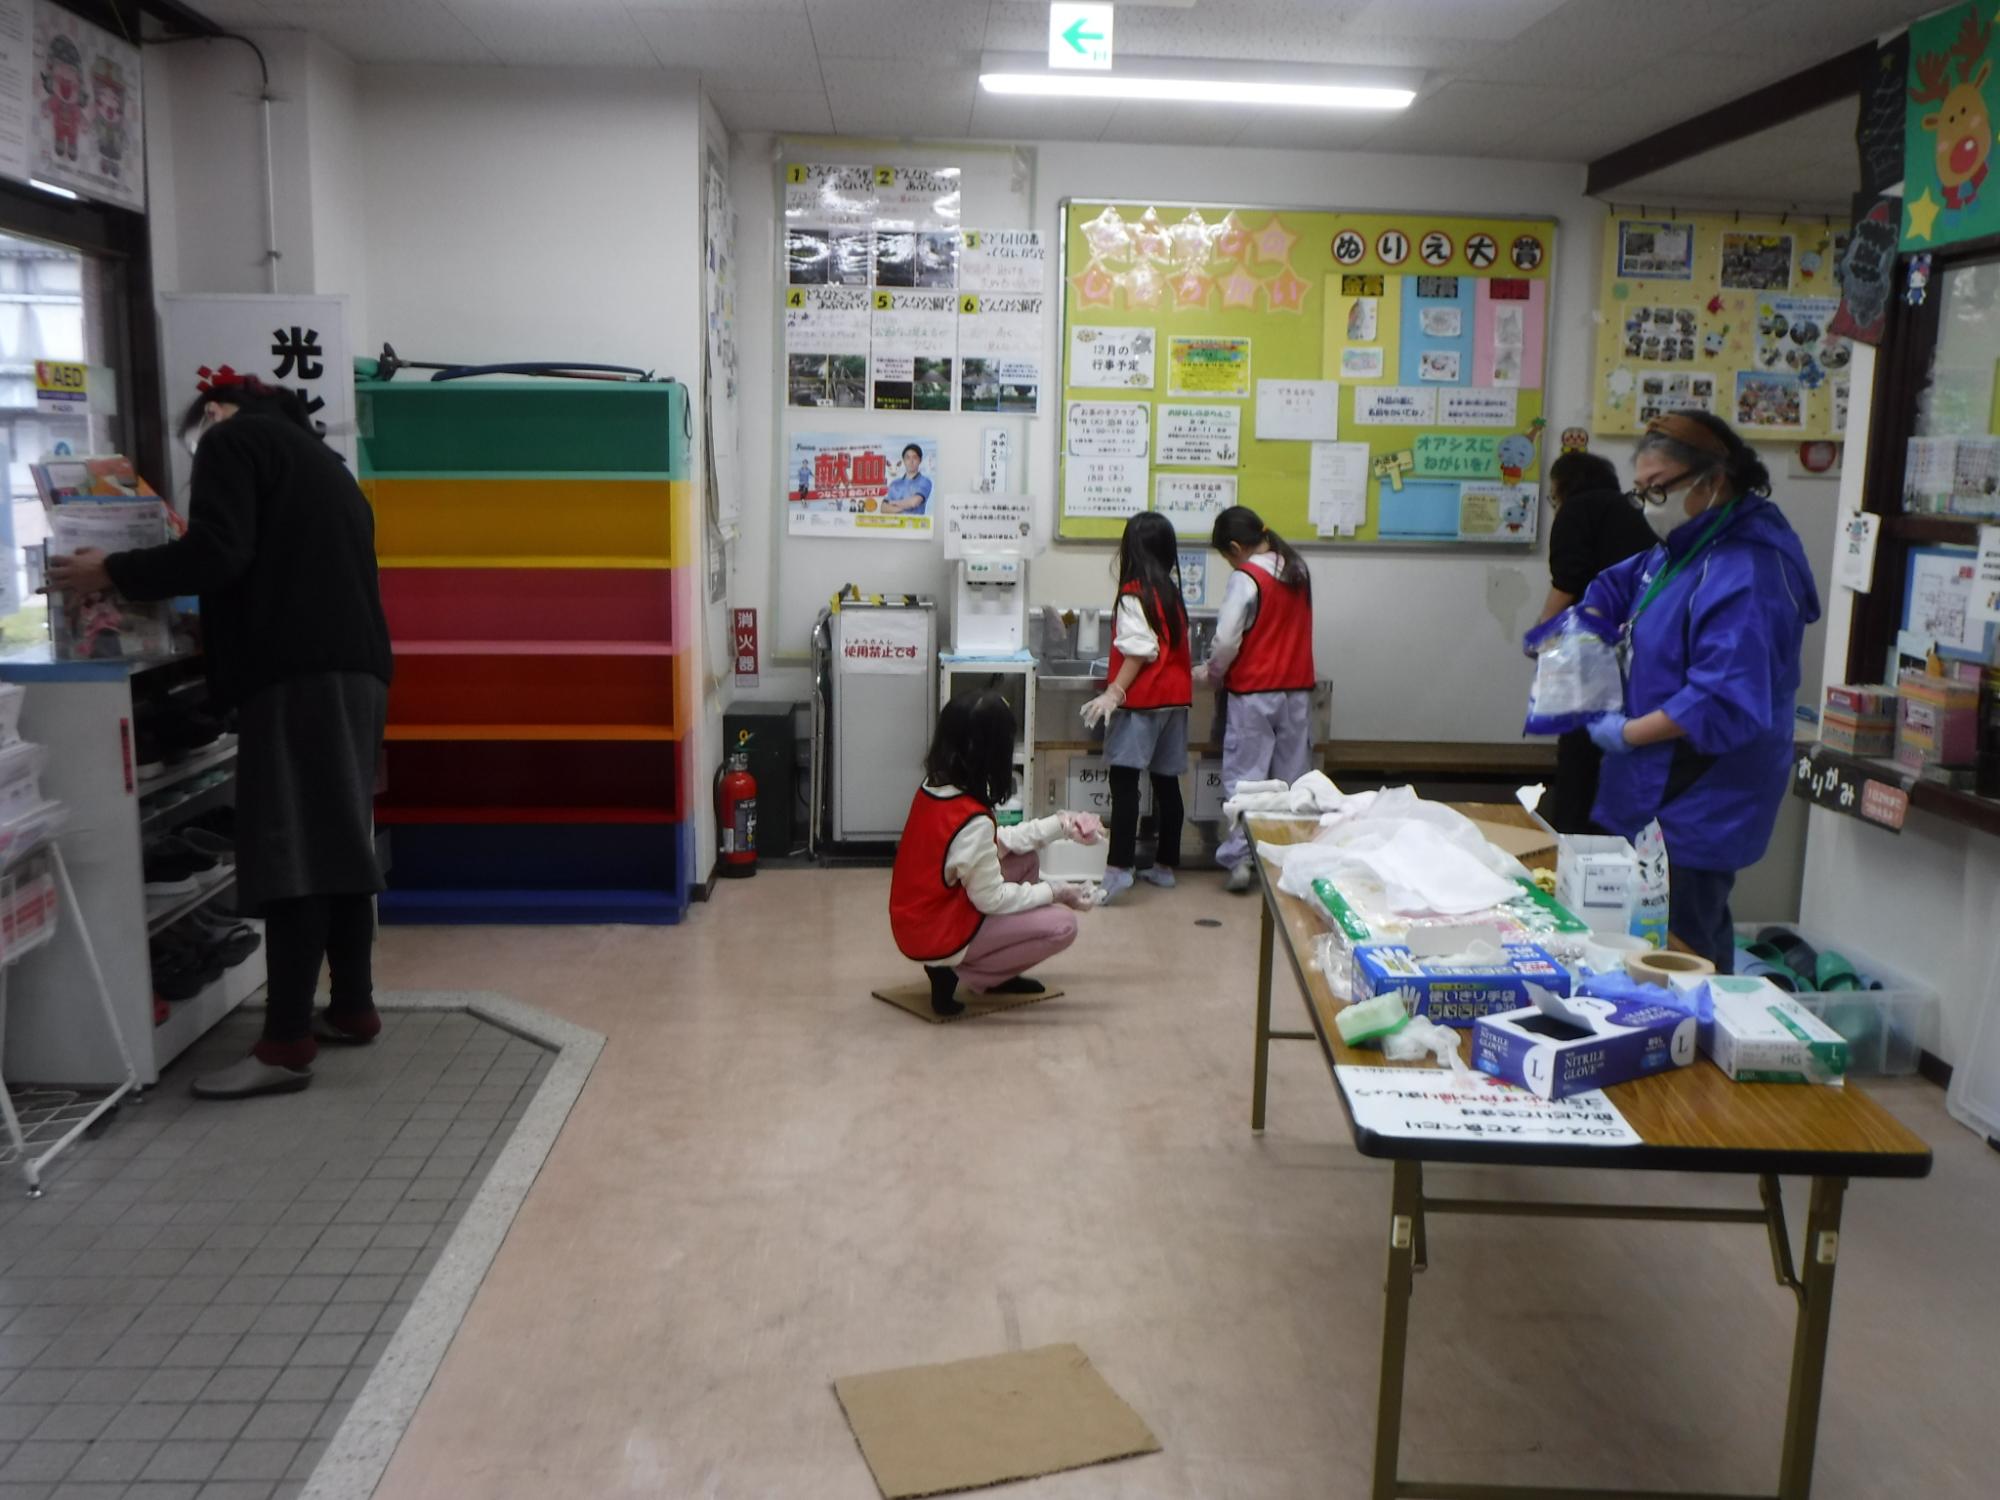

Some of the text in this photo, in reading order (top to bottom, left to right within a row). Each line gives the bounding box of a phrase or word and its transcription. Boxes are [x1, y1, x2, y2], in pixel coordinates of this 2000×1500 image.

[880, 171, 890, 184] 2
[966, 234, 975, 248] 3
[790, 292, 801, 306] 4
[876, 295, 888, 309] 5
[964, 298, 974, 312] 6
[53, 366, 82, 387] AED
[1416, 438, 1494, 452] オアシスに
[815, 451, 887, 489] 献血
[738, 612, 754, 671] 消火器
[844, 645, 918, 658] 使用禁止です
[1798, 756, 1855, 806] おりがみ
[1679, 1035, 1689, 1053] L
[1564, 1051, 1605, 1068] NITRILE
[1532, 1059, 1544, 1081] L
[1564, 1066, 1597, 1081] GLOVE
